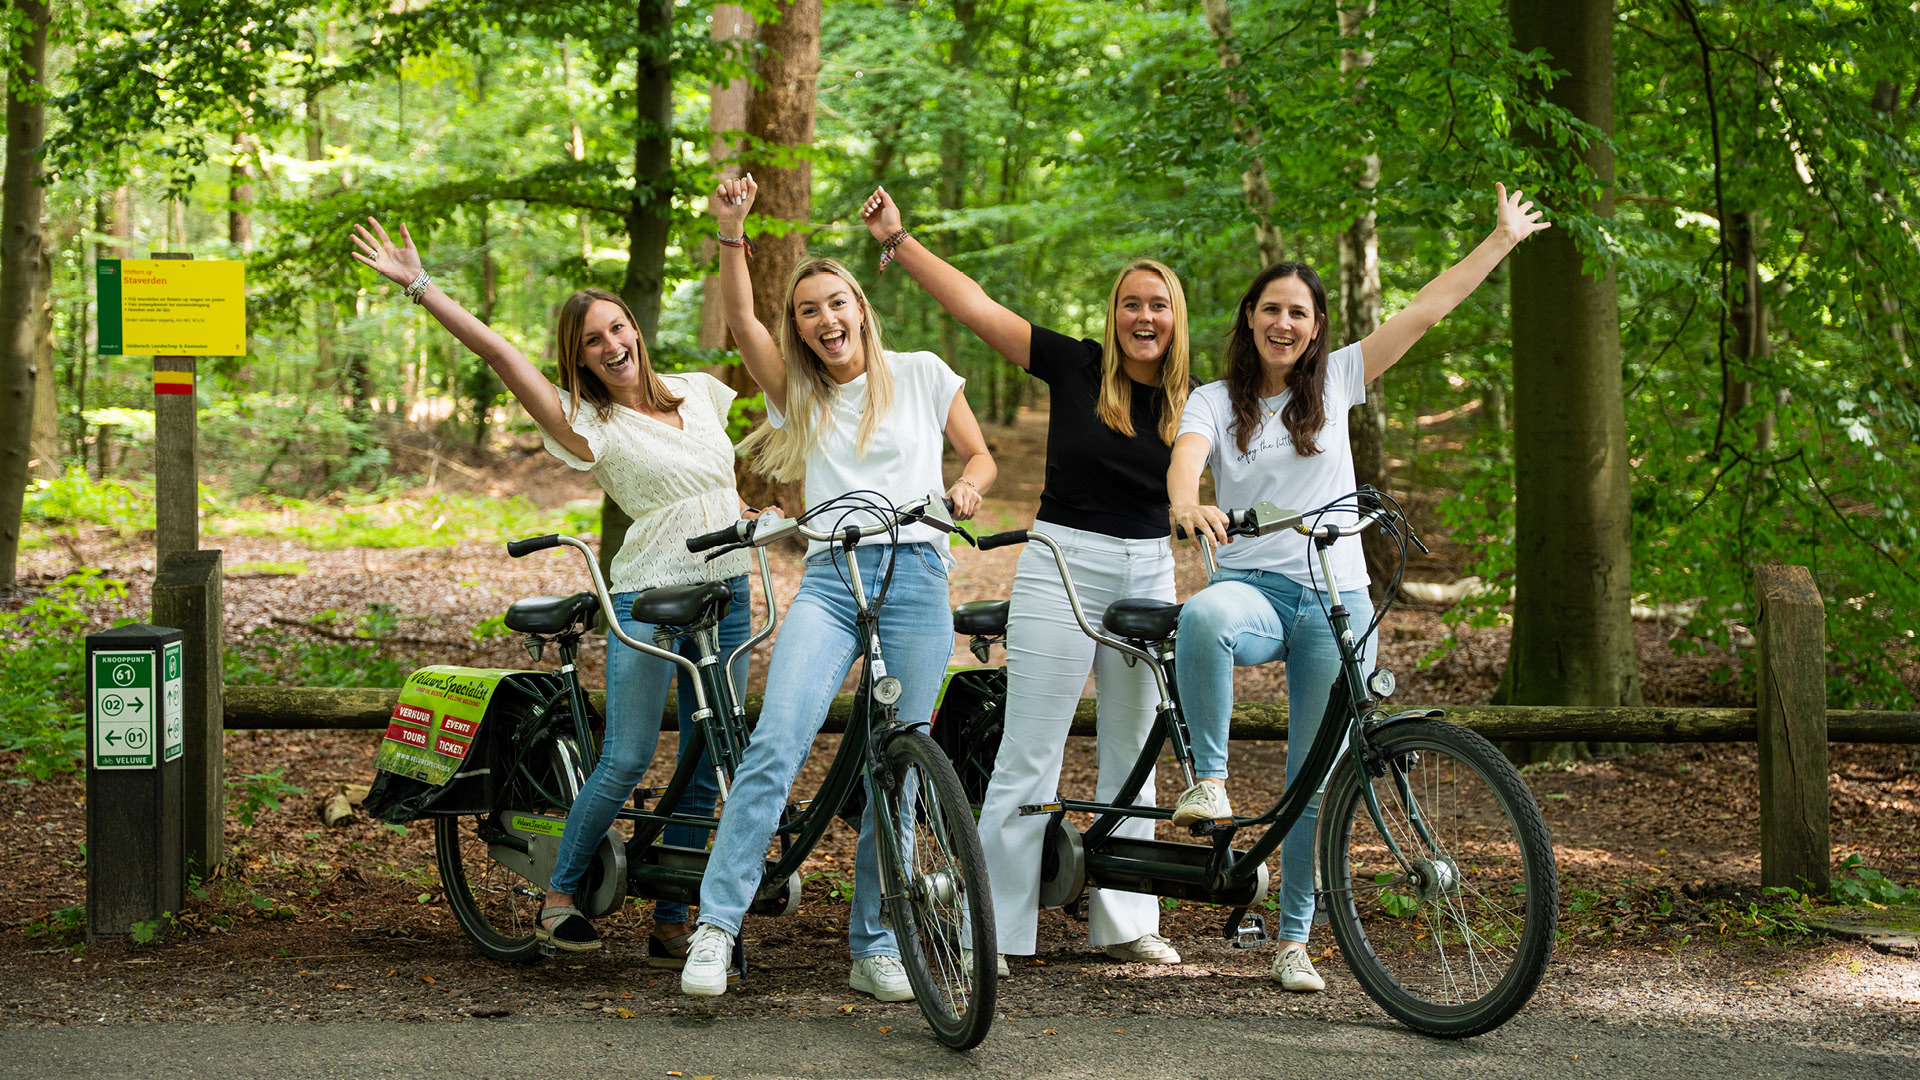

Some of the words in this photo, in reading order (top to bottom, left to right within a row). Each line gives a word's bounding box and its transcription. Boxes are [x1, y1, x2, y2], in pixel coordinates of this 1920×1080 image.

[124, 276, 167, 284] Staverden
[1260, 439, 1274, 452] the
[1276, 435, 1293, 448] littl
[116, 670, 131, 680] 61
[105, 700, 120, 710] 02
[399, 708, 431, 723] VERHUUR
[445, 720, 471, 732] EVENTS
[128, 733, 142, 742] 01
[402, 730, 426, 744] TOURS
[439, 740, 463, 754] TICKETS
